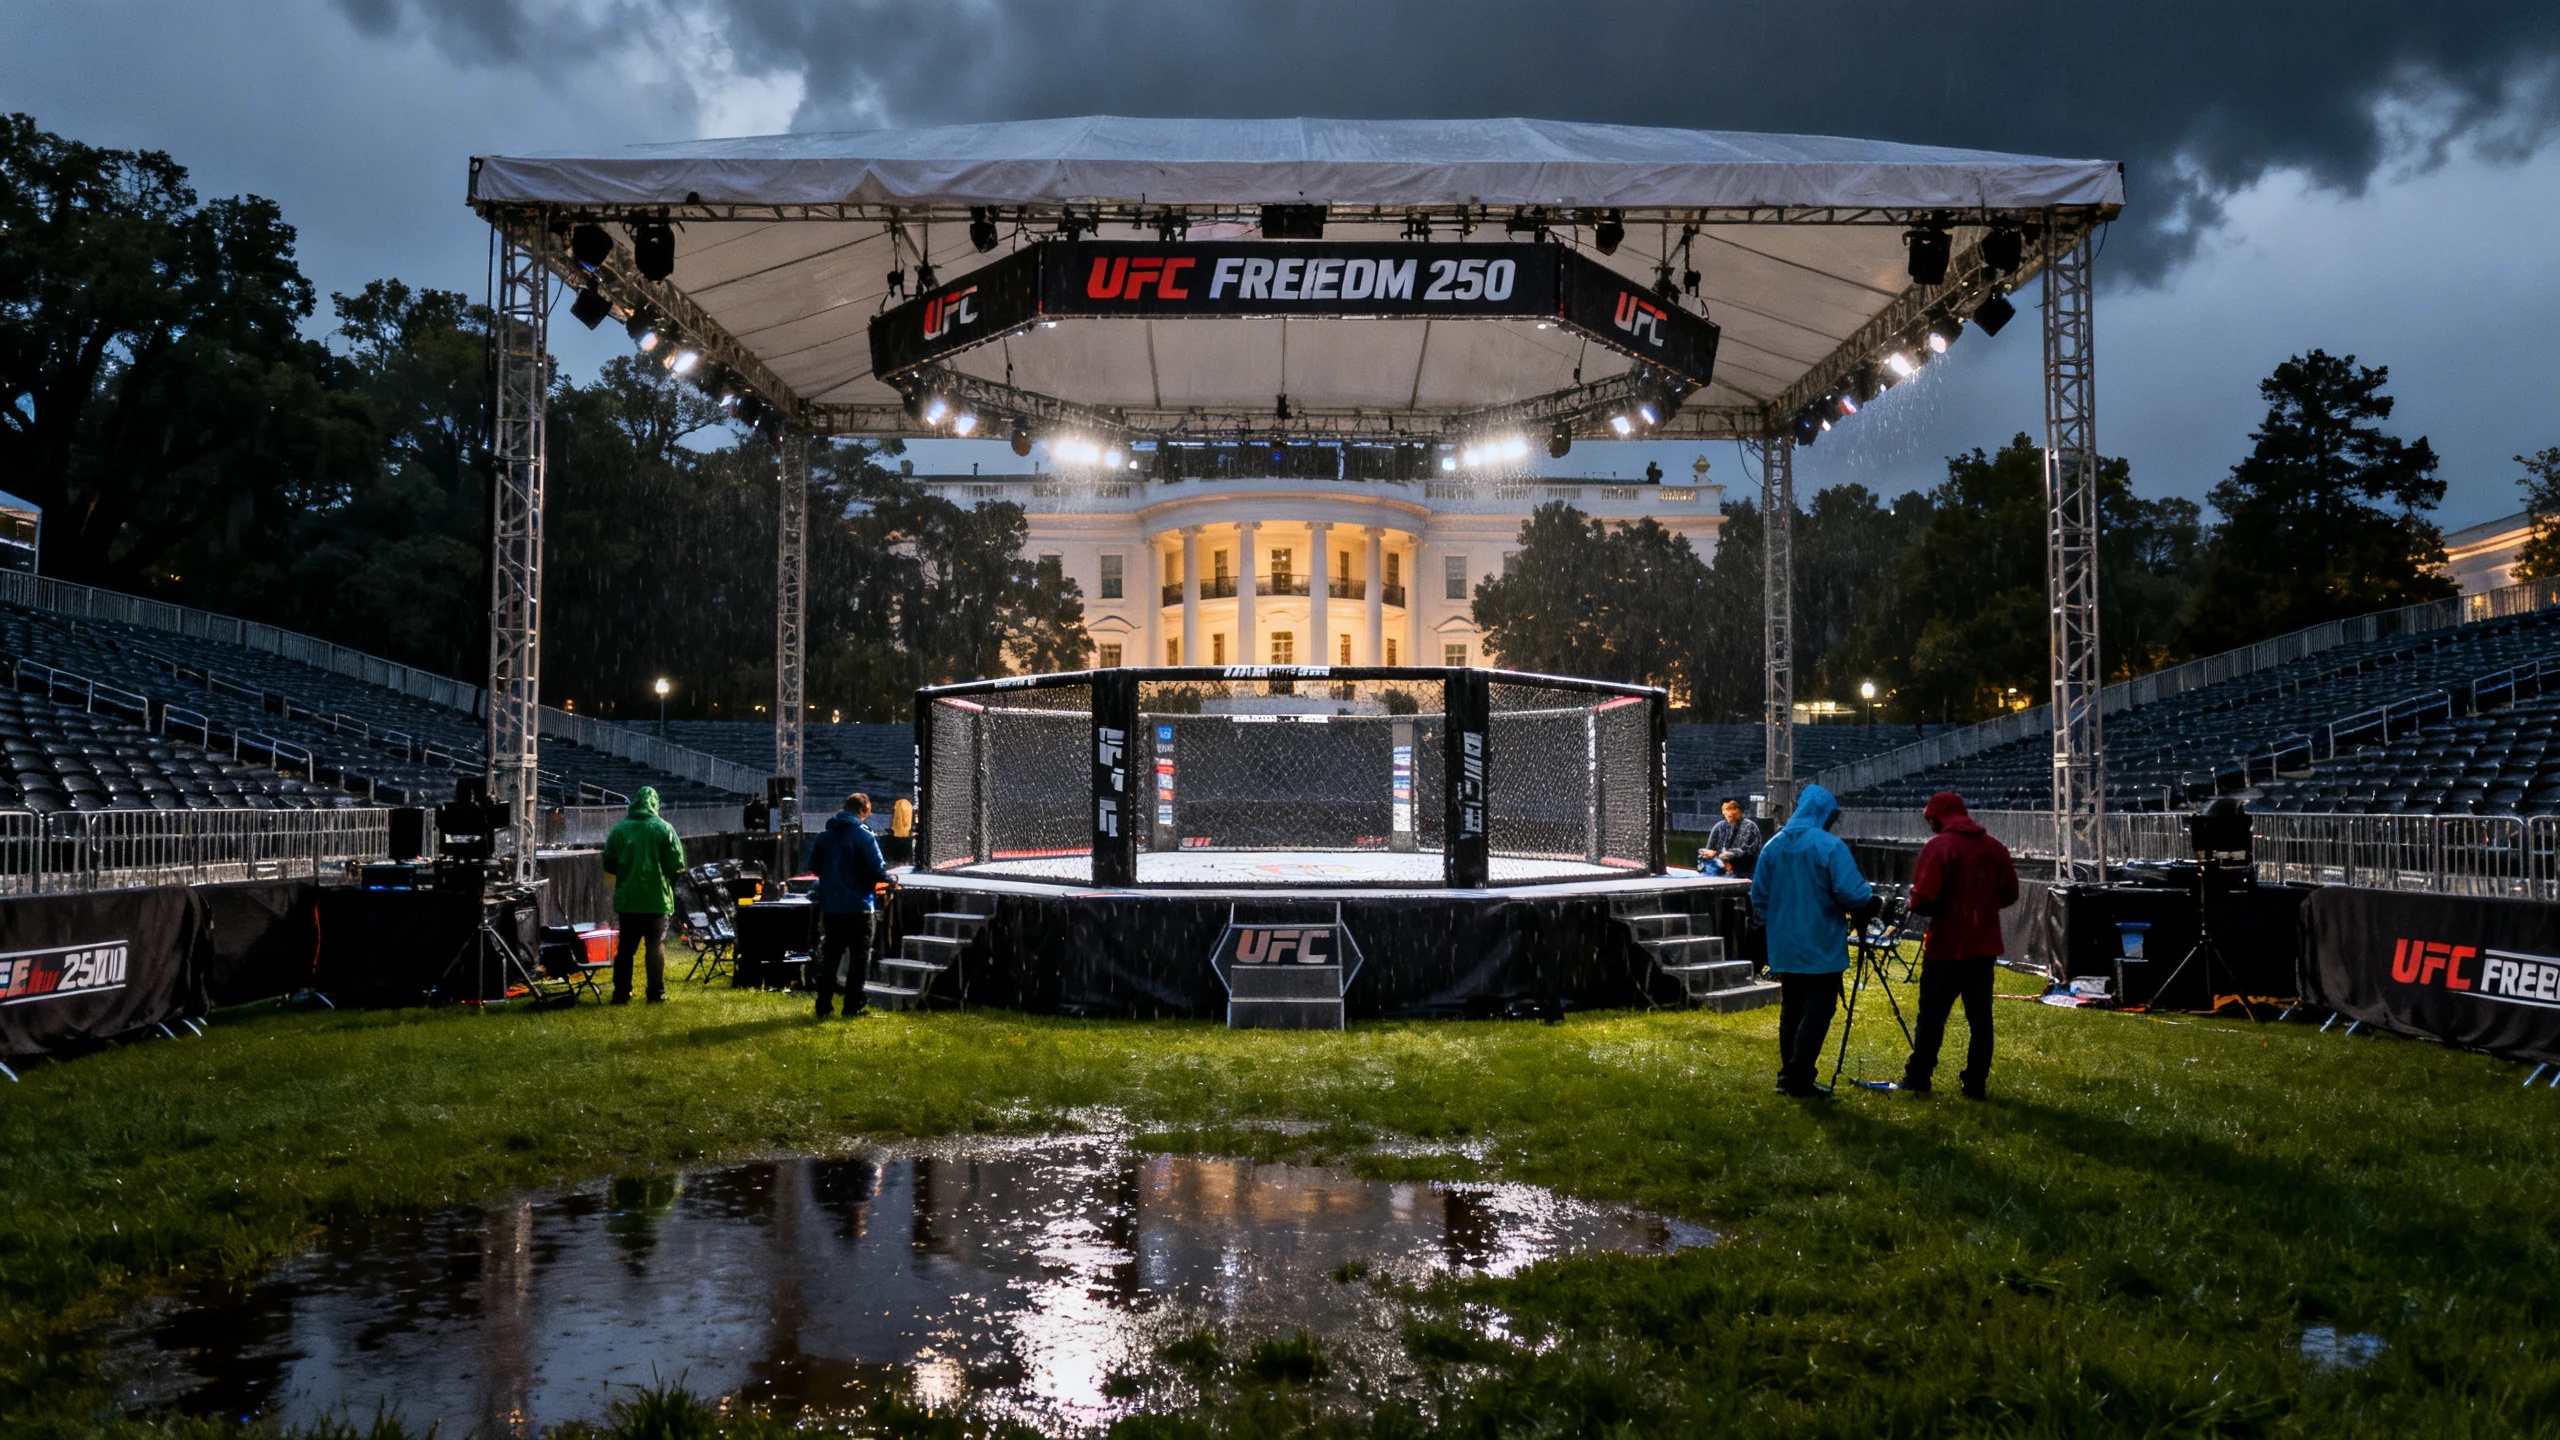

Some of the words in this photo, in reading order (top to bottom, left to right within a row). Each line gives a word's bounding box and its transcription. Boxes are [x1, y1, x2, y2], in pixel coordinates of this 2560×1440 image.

[1087, 257, 1196, 299] UFC
[1424, 259, 1517, 301] 250
[924, 285, 978, 340] UFC
[1614, 291, 1668, 347] UFC
[1236, 929, 1330, 964] UFC
[2391, 938, 2477, 990] UFC
